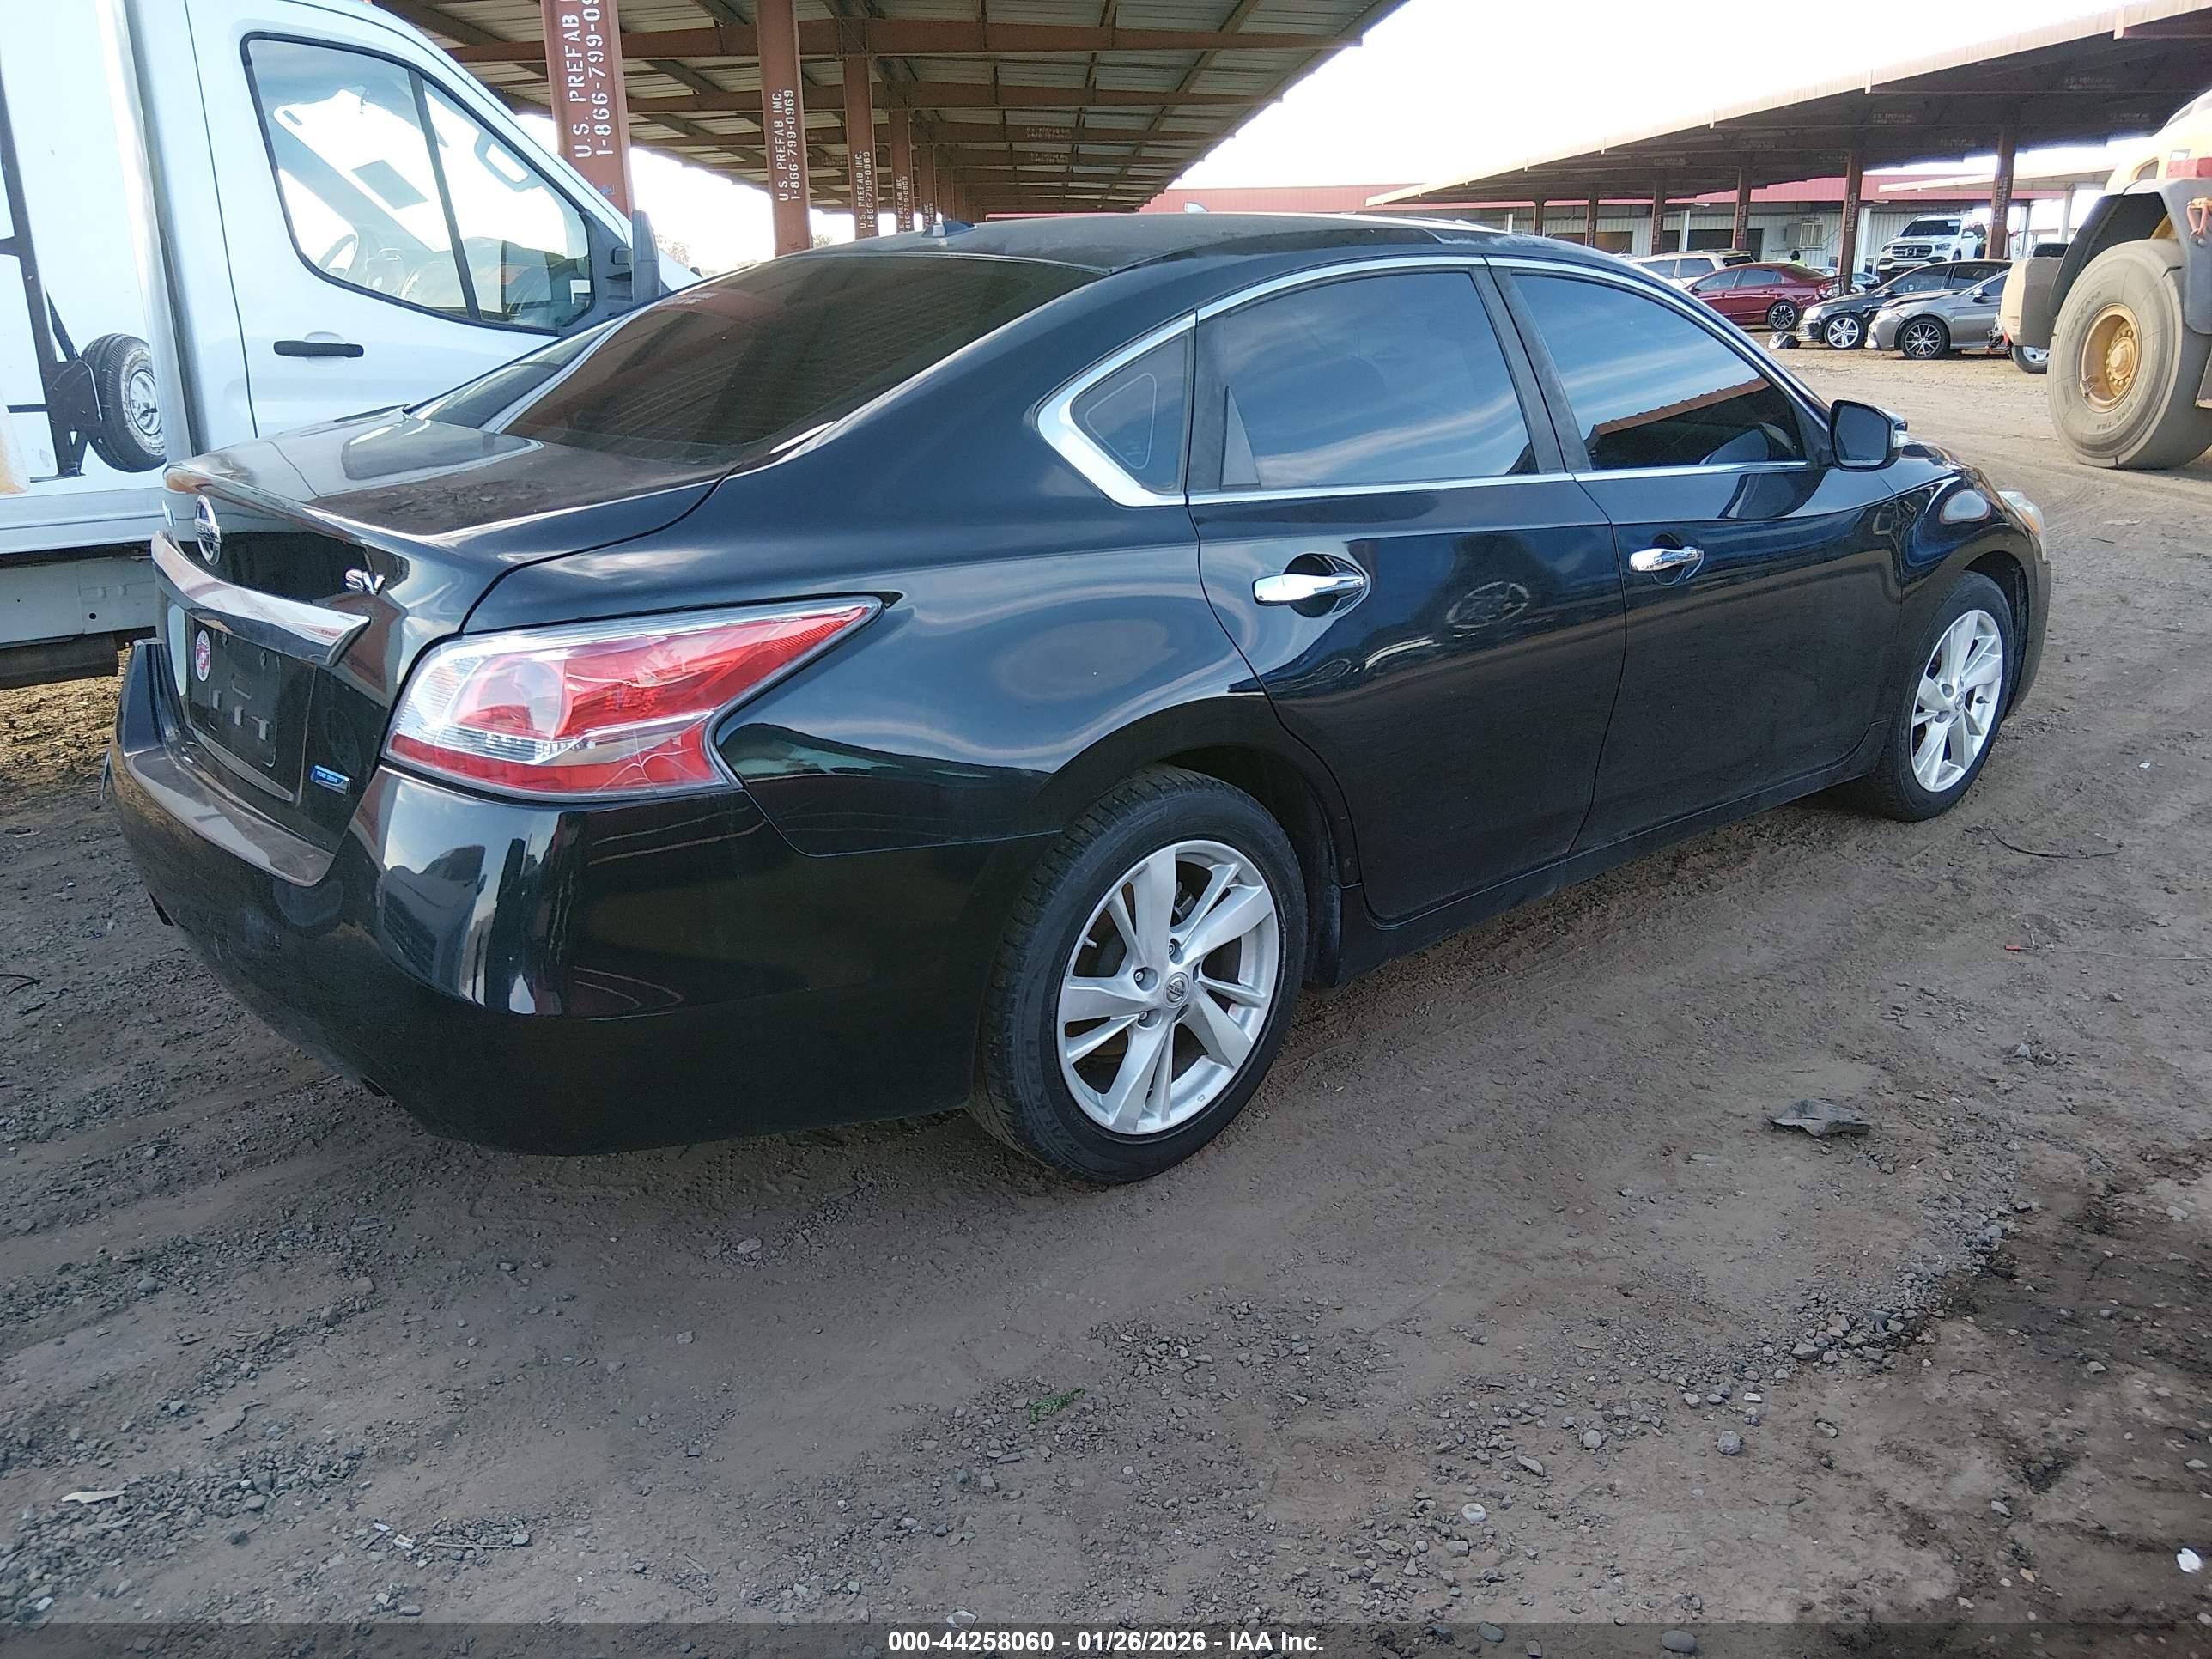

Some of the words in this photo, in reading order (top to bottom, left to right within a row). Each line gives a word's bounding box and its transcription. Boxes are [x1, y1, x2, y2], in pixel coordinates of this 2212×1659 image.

[562, 15, 587, 102] PREFAB
[772, 88, 783, 113] INC.
[572, 116, 592, 158] U.S.
[774, 120, 787, 170] PREFAB
[783, 89, 800, 200] 1-866-799-0969
[854, 150, 863, 168] INC.
[778, 176, 789, 201] U.S.
[856, 172, 866, 207] PREFAB
[345, 568, 386, 596] SV
